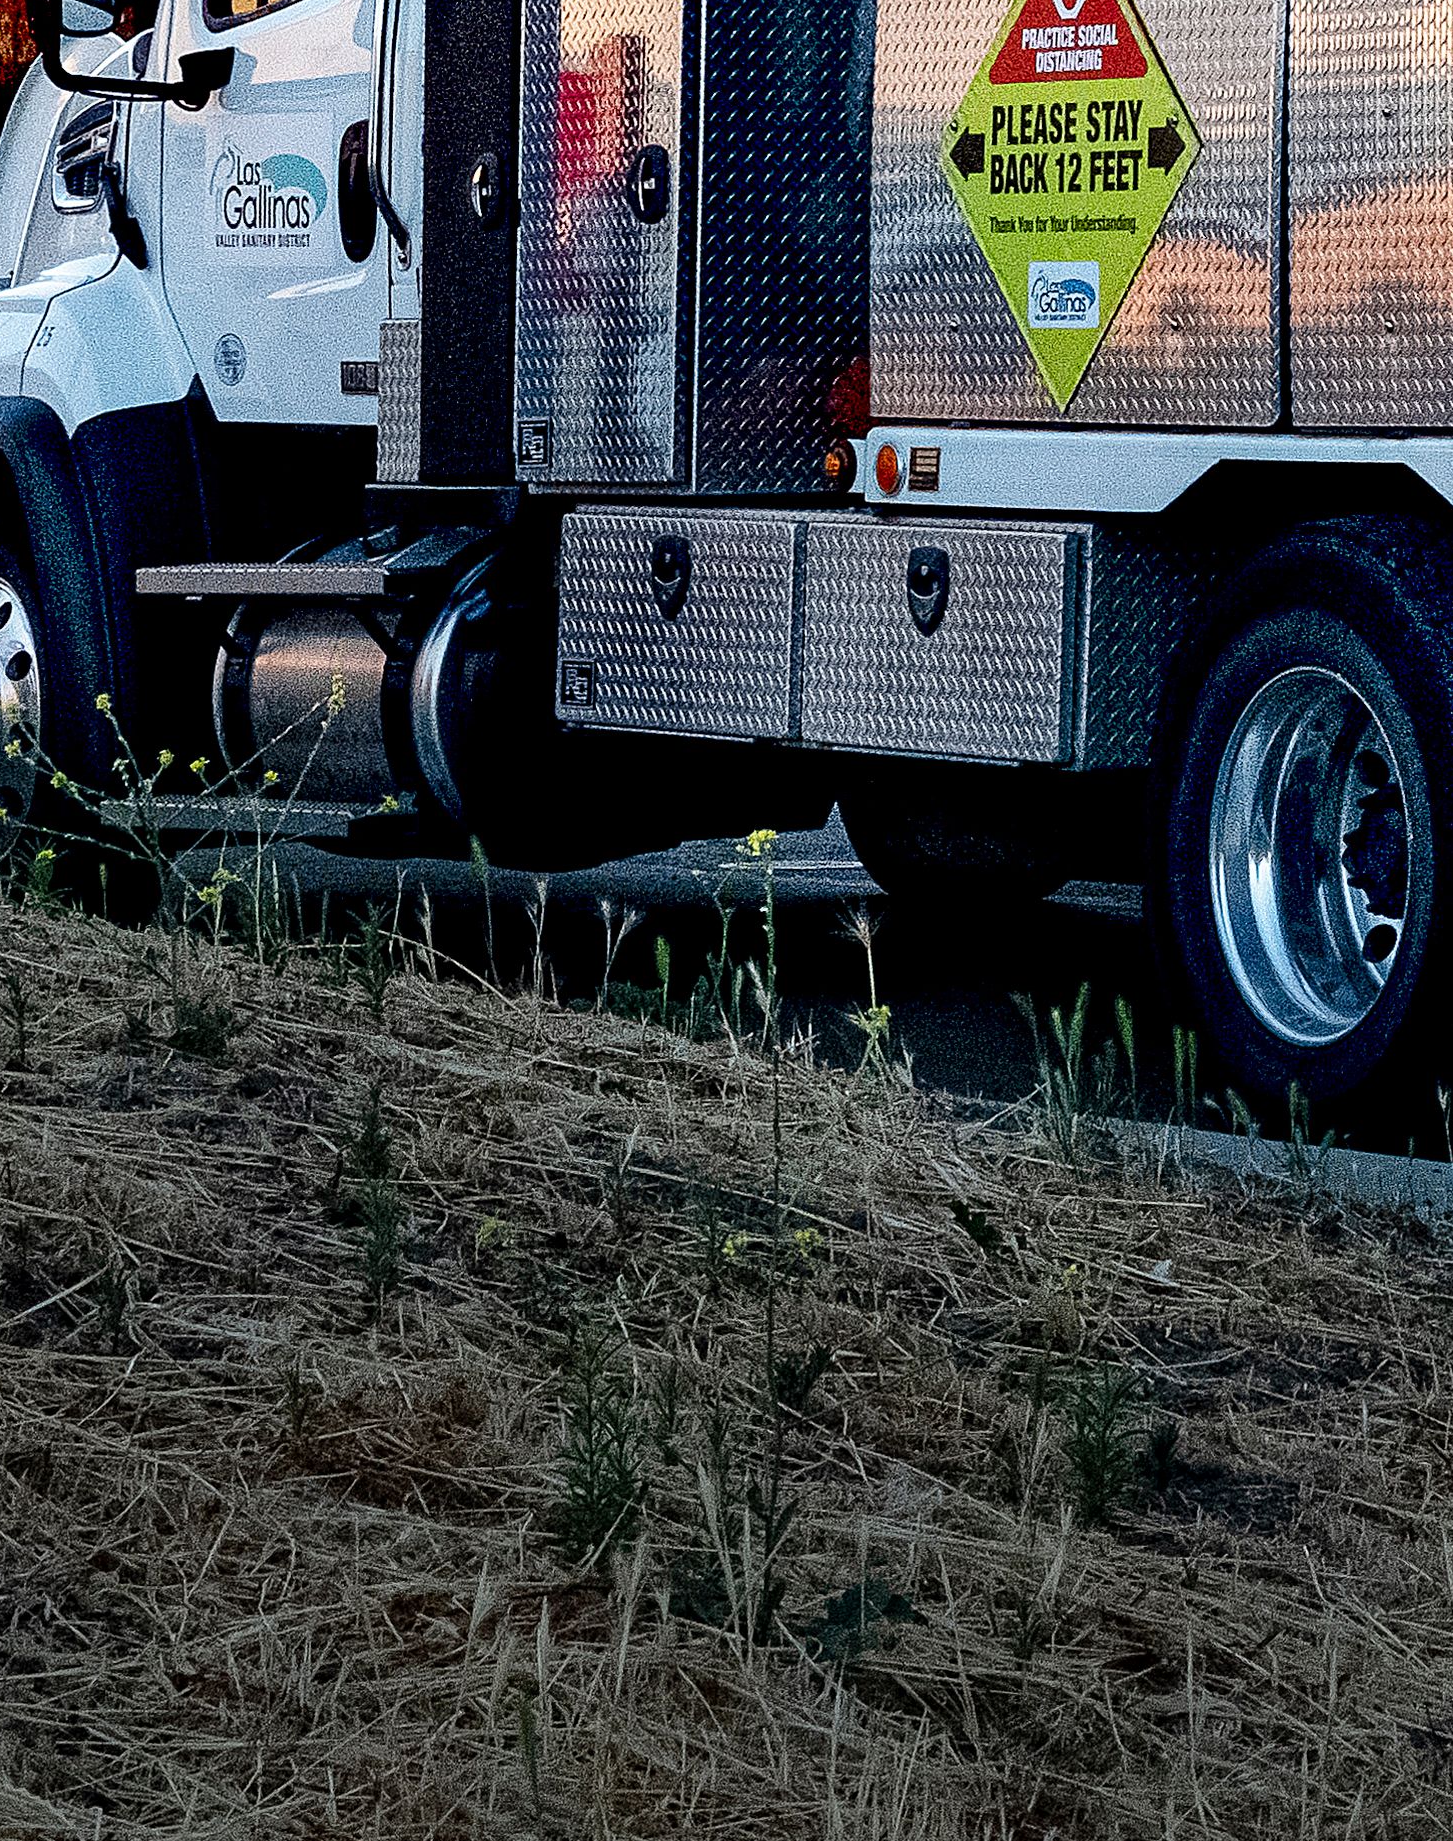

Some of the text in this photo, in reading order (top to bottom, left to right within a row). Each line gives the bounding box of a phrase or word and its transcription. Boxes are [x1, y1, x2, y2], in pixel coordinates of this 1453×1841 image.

[1021, 24, 1119, 50] PRACTICE SOCIAL
[1035, 48, 1103, 73] DISTANCING
[991, 99, 1143, 146] PLEASE STAY
[236, 155, 261, 186] Las
[990, 149, 1143, 195] BACK 12 FEET
[223, 185, 310, 230] Gallinas
[990, 215, 1017, 233] Thank
[1018, 216, 1034, 233] You
[1049, 215, 1069, 232] Your
